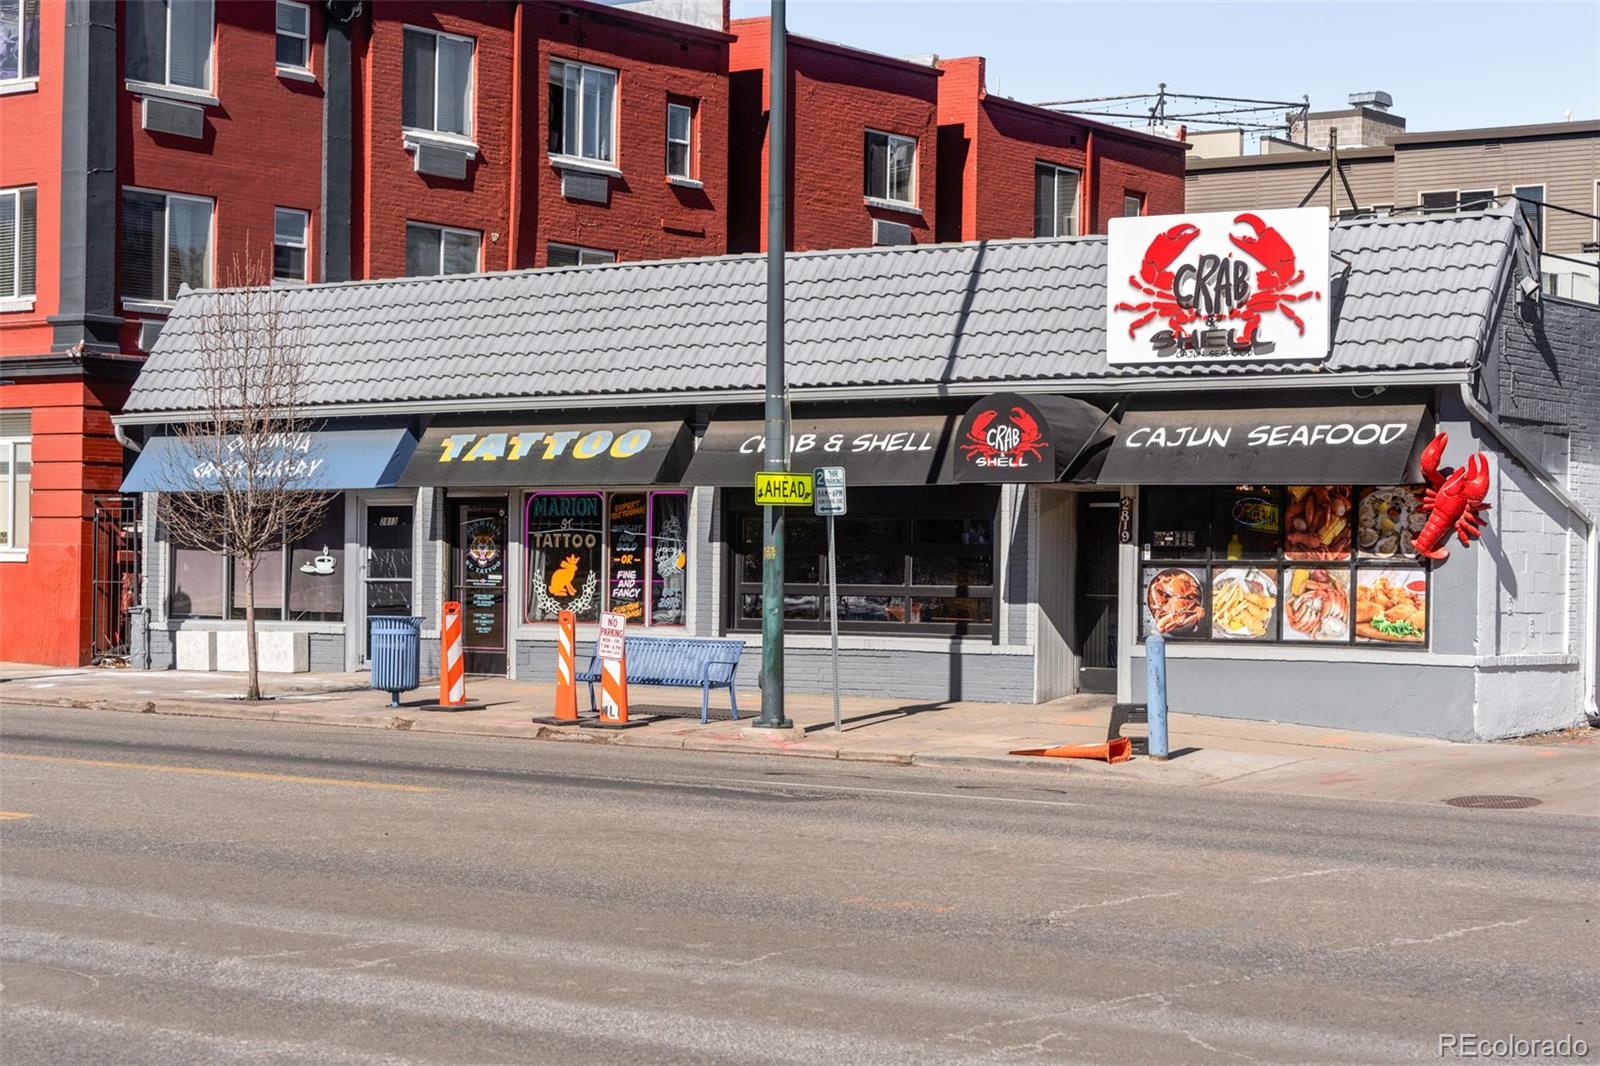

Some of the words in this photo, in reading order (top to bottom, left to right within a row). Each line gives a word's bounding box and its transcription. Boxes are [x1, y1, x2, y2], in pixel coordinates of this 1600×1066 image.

[1173, 254, 1250, 315] CRAB
[1149, 328, 1276, 356] SHELL
[739, 434, 817, 454] CB
[824, 435, 845, 453] &
[852, 432, 932, 452] SHELL
[986, 425, 1020, 452] CRAB
[1125, 427, 1232, 447] CAJUN
[1247, 423, 1408, 446] SEAFOOD
[439, 429, 652, 463] TATTOO
[976, 457, 1029, 467] SHELL
[816, 471, 824, 485] 2
[765, 481, 806, 498] AHEAD
[532, 496, 598, 517] MARION
[1120, 499, 1130, 542] 2819
[533, 533, 597, 549] TATTOO
[616, 542, 638, 551] BOLD
[475, 560, 501, 574] TATTOO
[617, 570, 637, 579] FINE
[617, 579, 636, 589] AND
[612, 588, 642, 598] FANCY
[607, 618, 619, 628] NO
[601, 627, 623, 639] PARKING
